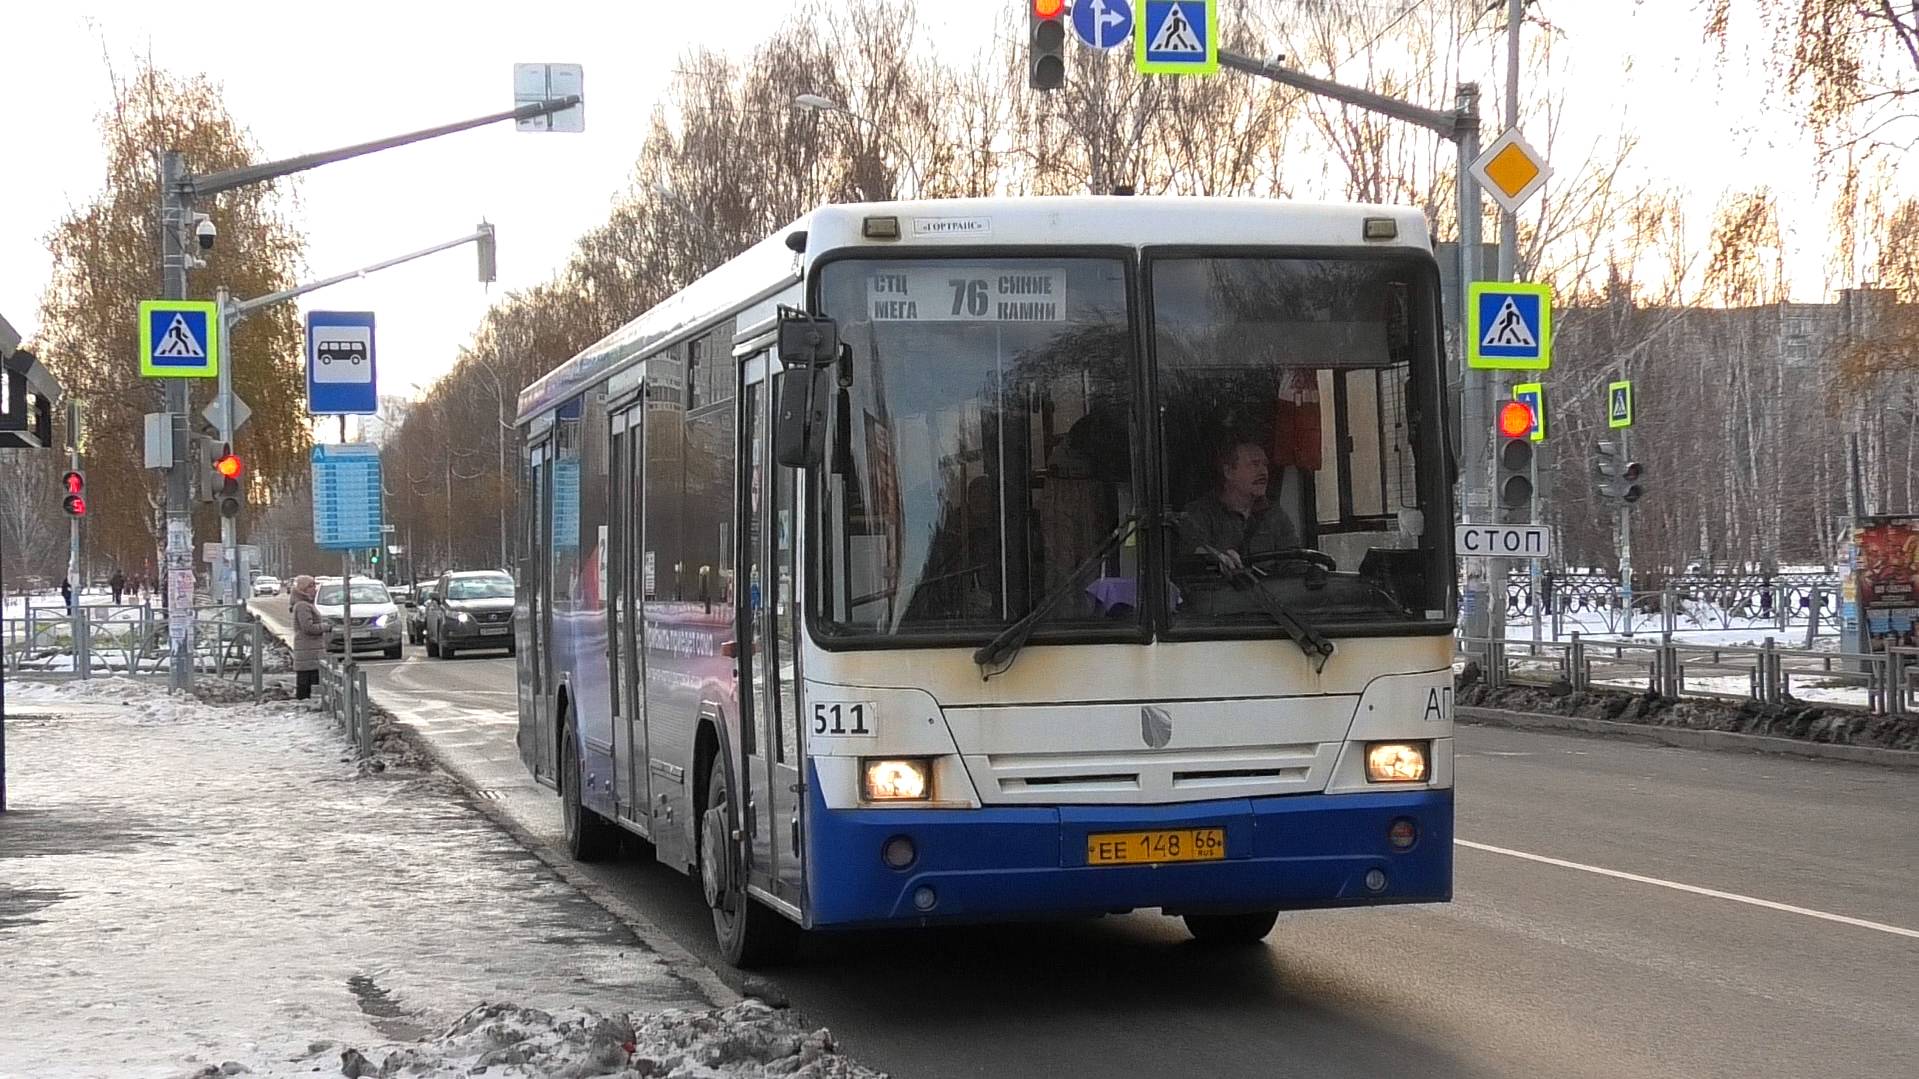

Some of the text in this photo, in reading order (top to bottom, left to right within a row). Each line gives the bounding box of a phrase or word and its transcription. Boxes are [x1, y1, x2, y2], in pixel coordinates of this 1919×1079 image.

[874, 274, 908, 296] СТЦ
[998, 276, 1052, 294] СИНИЕ
[948, 279, 989, 316] 76
[875, 301, 918, 319] МЕГА
[997, 302, 1056, 320] КАМНИ
[1464, 530, 1541, 552] СТОП
[814, 704, 869, 734] 511
[1140, 835, 1180, 857] 148
[1195, 831, 1217, 849] 66
